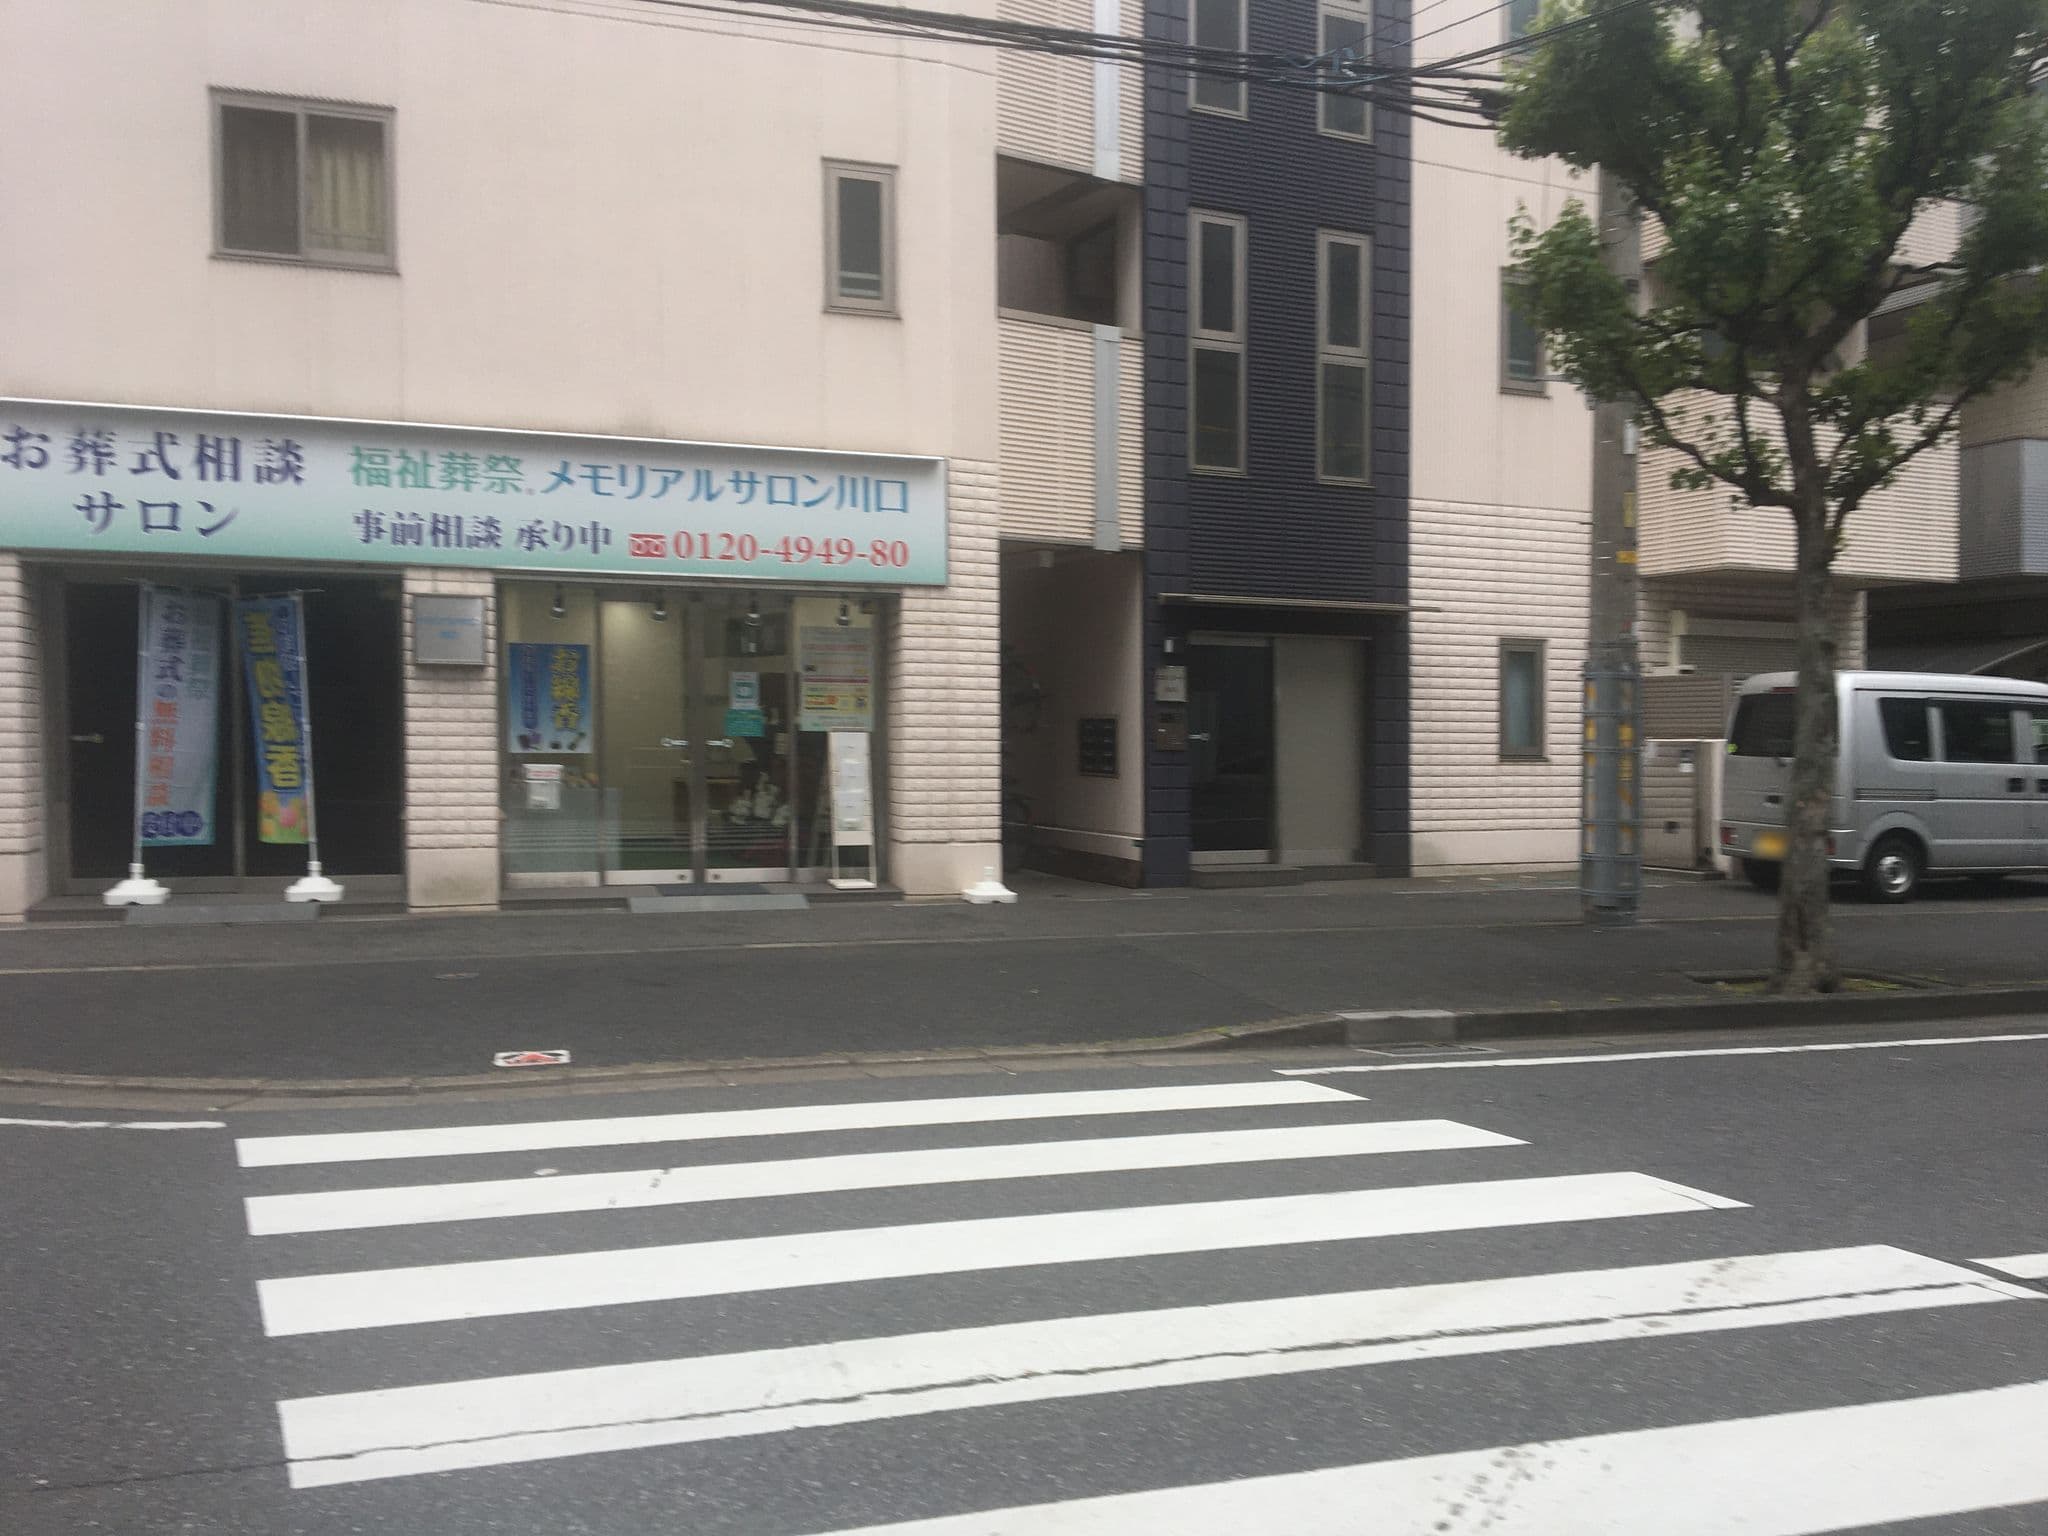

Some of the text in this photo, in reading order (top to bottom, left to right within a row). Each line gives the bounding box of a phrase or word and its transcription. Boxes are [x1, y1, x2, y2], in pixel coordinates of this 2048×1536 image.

[1, 424, 304, 484] お葬式相談
[349, 446, 909, 513] 福祉葬祭 メモリアルサロン川口
[73, 490, 239, 537] サロン
[353, 508, 909, 567] 事前相談 承り中 0120-4949-80
